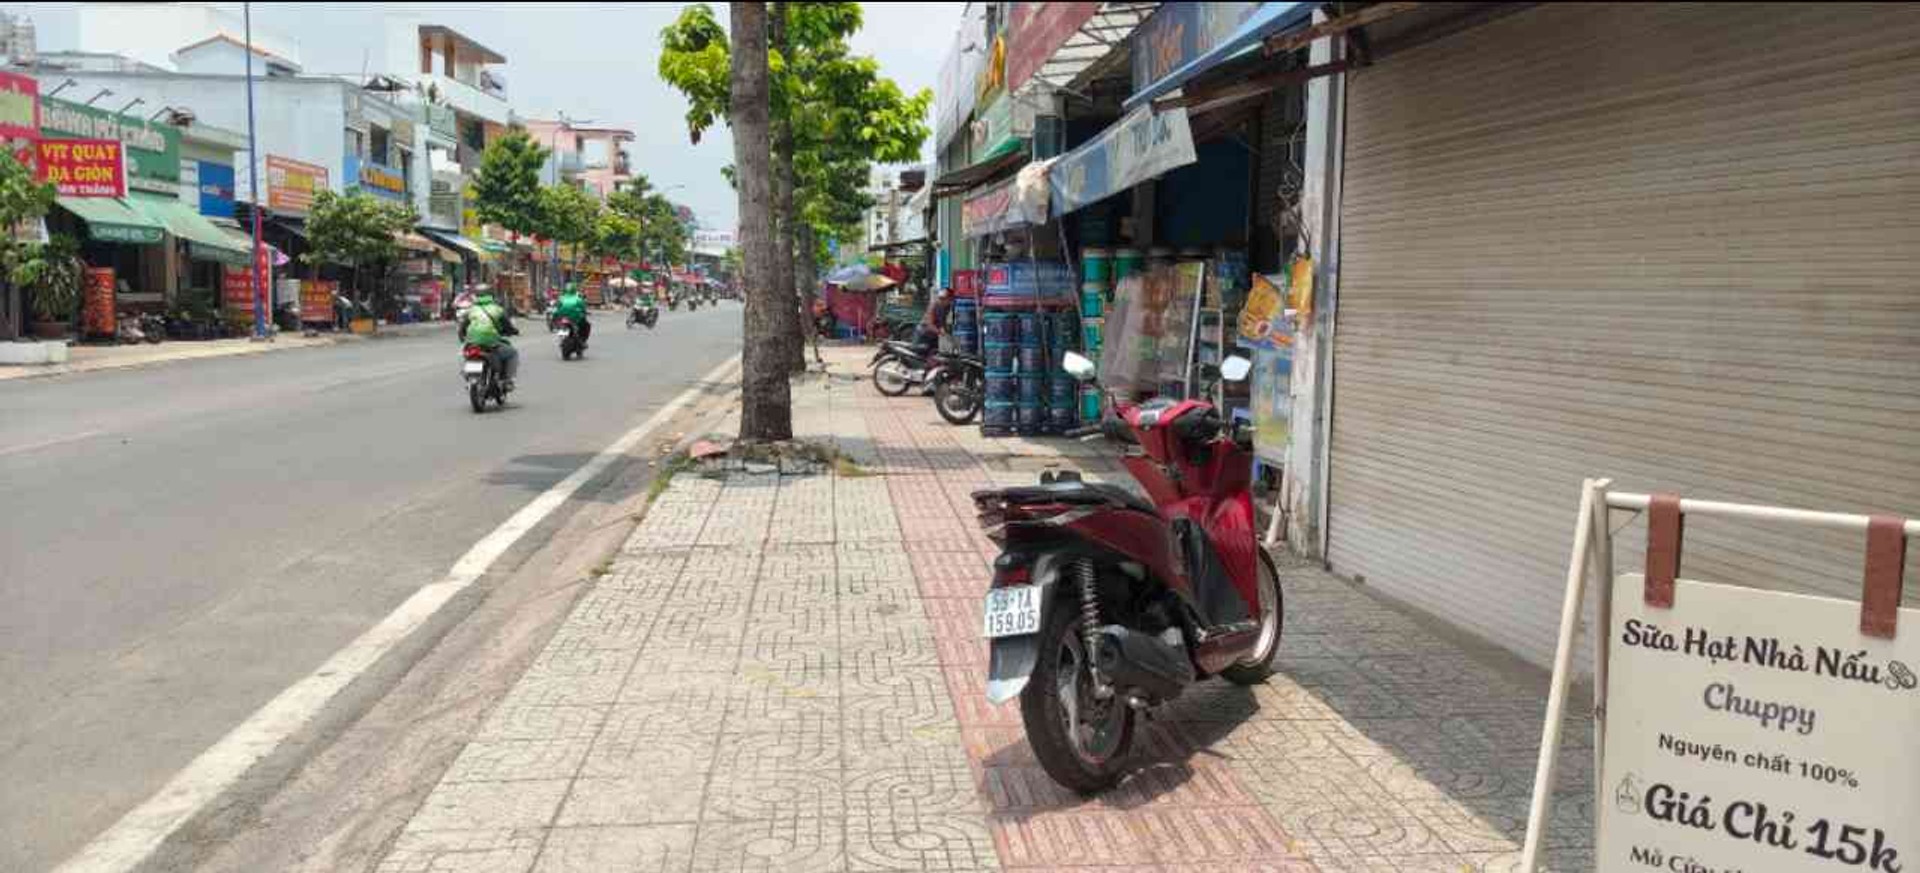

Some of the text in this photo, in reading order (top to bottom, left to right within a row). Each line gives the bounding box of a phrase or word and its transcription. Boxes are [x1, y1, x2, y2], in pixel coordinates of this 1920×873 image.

[48, 165, 70, 182] DA
[73, 162, 115, 181] GIÒN
[72, 143, 117, 161] QUAY
[1622, 618, 1884, 685] Sữa Hạt Nhà Nấu
[1703, 683, 1816, 734] Chuppy
[1658, 733, 1860, 789] Nguyên chất 100%
[1644, 783, 1904, 873] Giá Chỉ 15k
